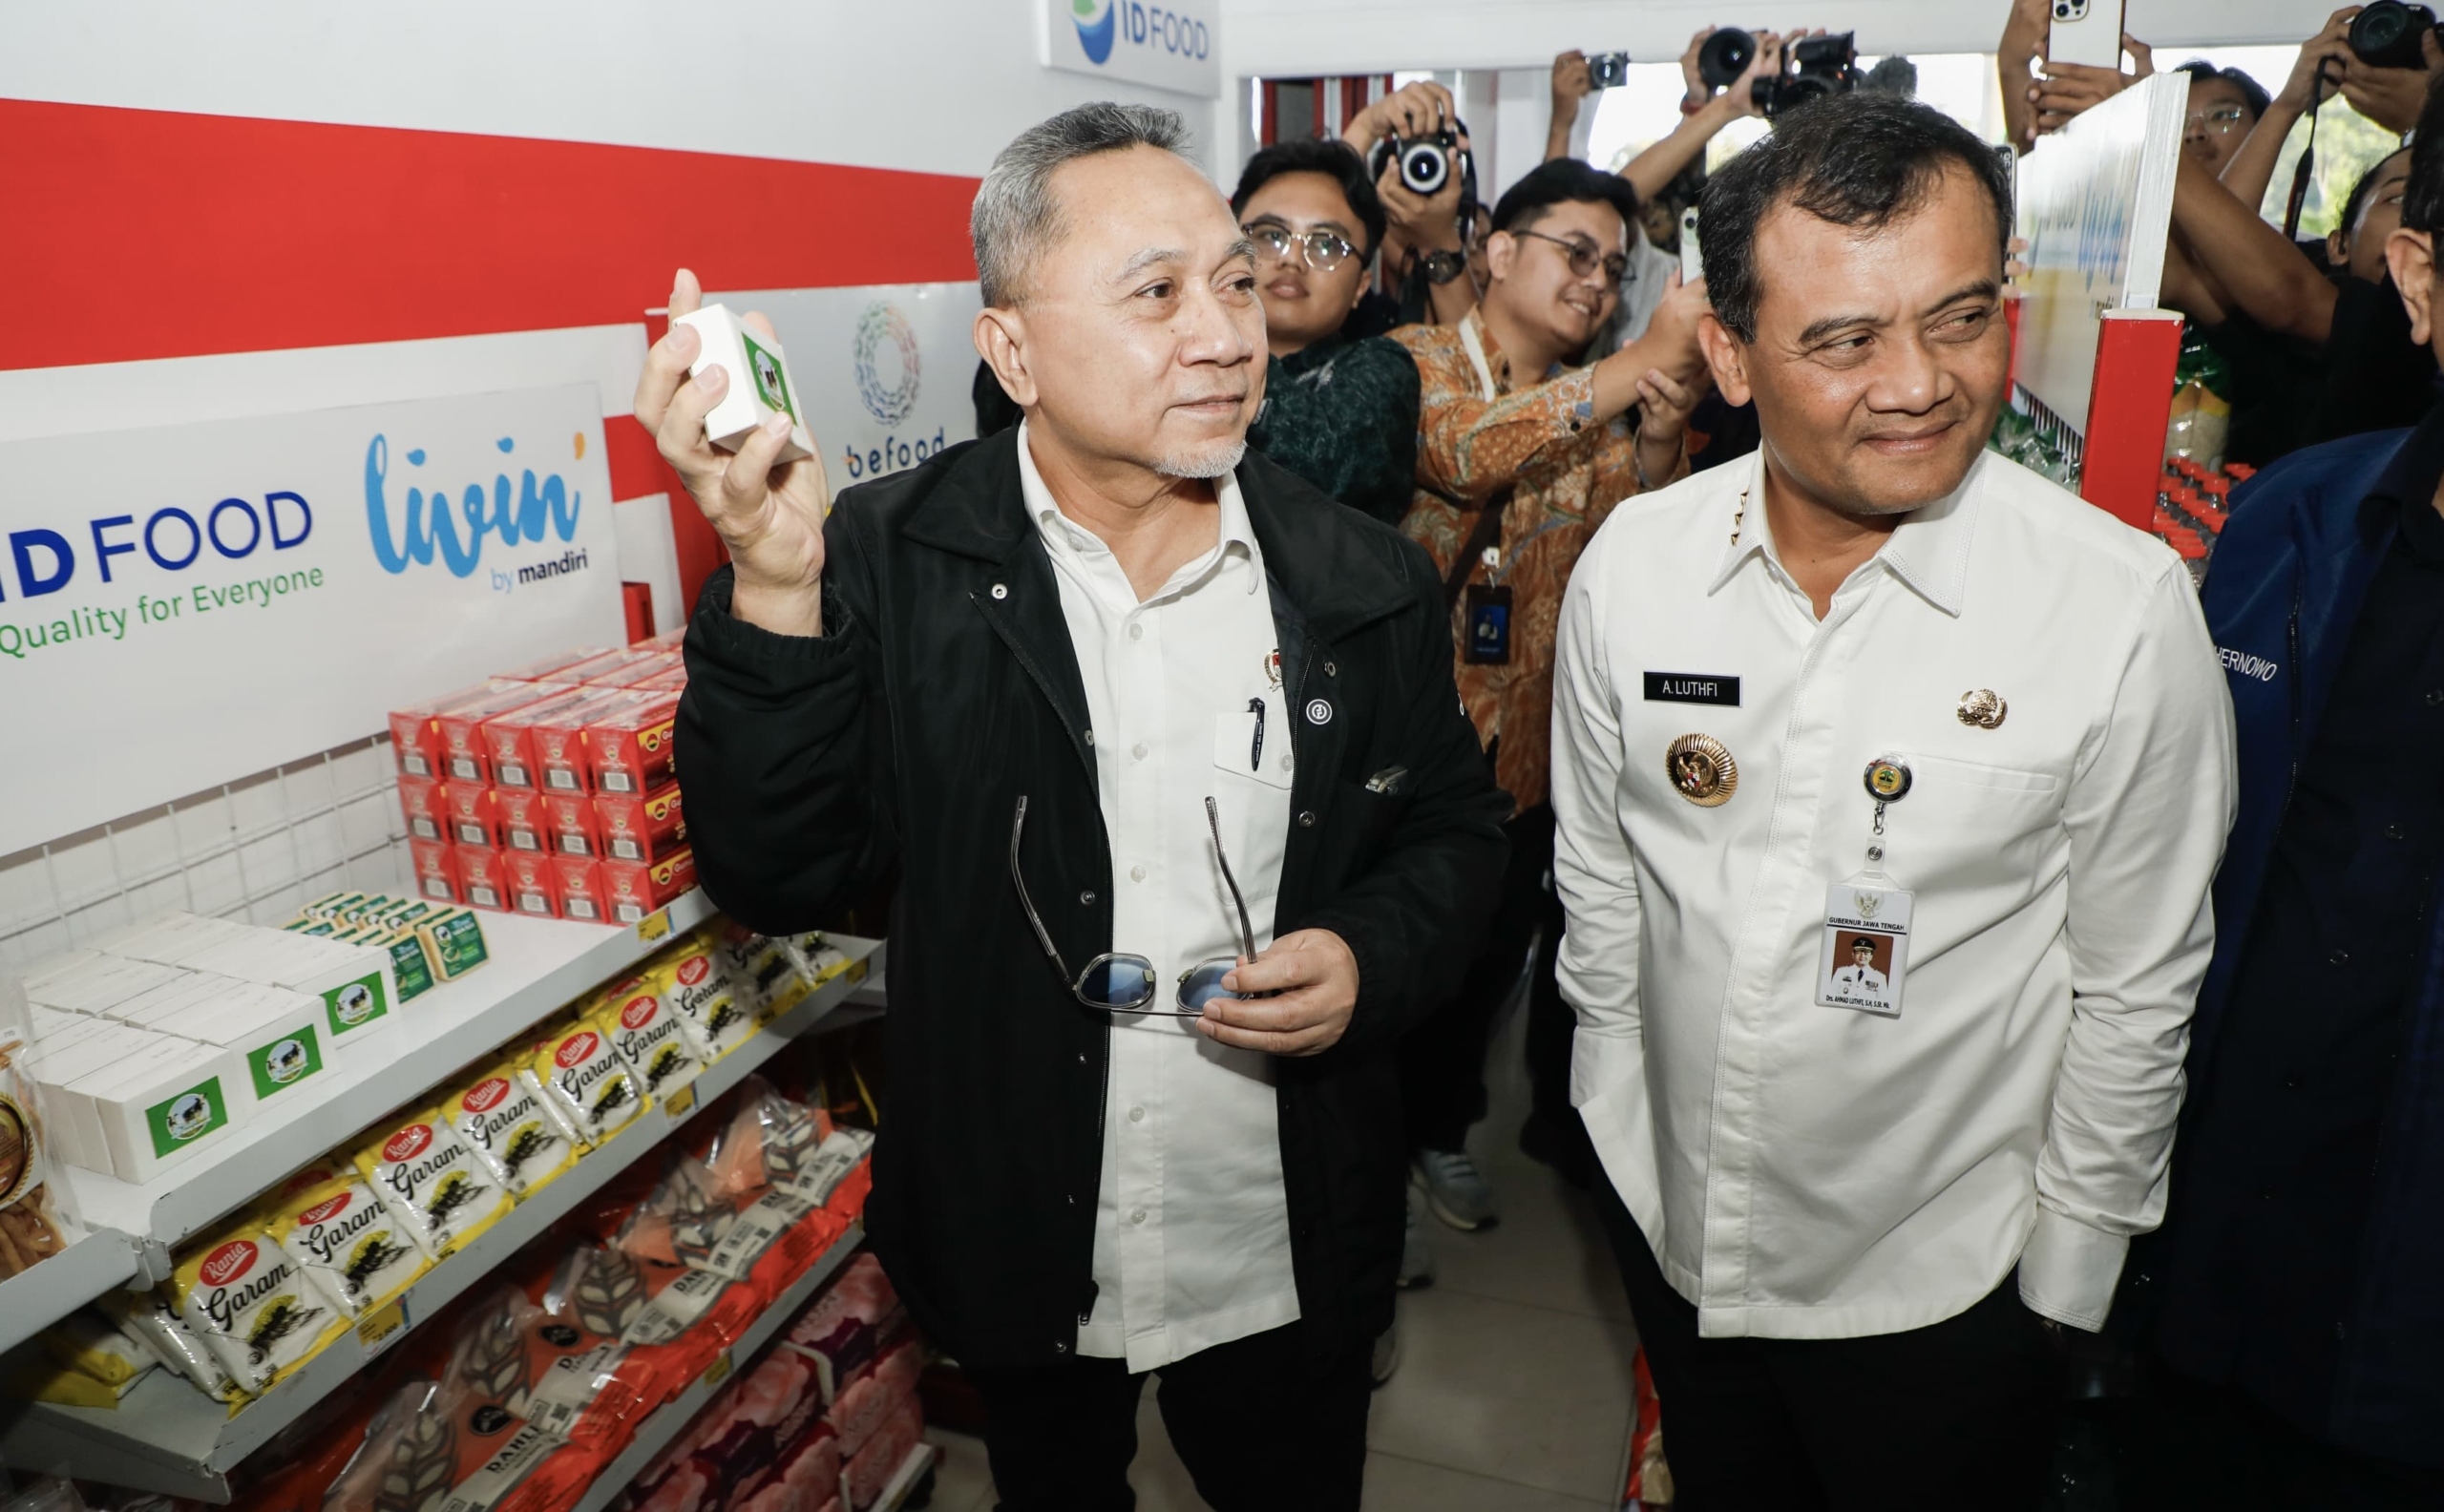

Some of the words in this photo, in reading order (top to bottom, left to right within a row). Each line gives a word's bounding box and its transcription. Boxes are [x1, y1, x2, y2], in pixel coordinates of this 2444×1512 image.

[1123, 0, 1147, 44] ID
[1150, 7, 1209, 60] FOOD
[847, 426, 944, 478] befood
[0, 529, 74, 603] D
[90, 491, 312, 583] FOOD
[491, 568, 514, 594] by
[518, 548, 588, 584] mandiri
[0, 606, 127, 659] Quality
[137, 595, 183, 623] for
[192, 568, 325, 613] Everyone
[1662, 680, 1674, 694] A.
[1675, 681, 1717, 697] LUTHFI
[1828, 916, 1862, 926] GUBERNUR
[1863, 920, 1879, 929] JAWA
[1881, 922, 1905, 931] TENGAH
[617, 1018, 680, 1064] Garam
[555, 1052, 623, 1102] Garam
[463, 1096, 538, 1149] Garam
[386, 1144, 465, 1200] Garam
[299, 1201, 387, 1263] Garam
[204, 1242, 247, 1280] Rania
[199, 1263, 290, 1332] Garam
